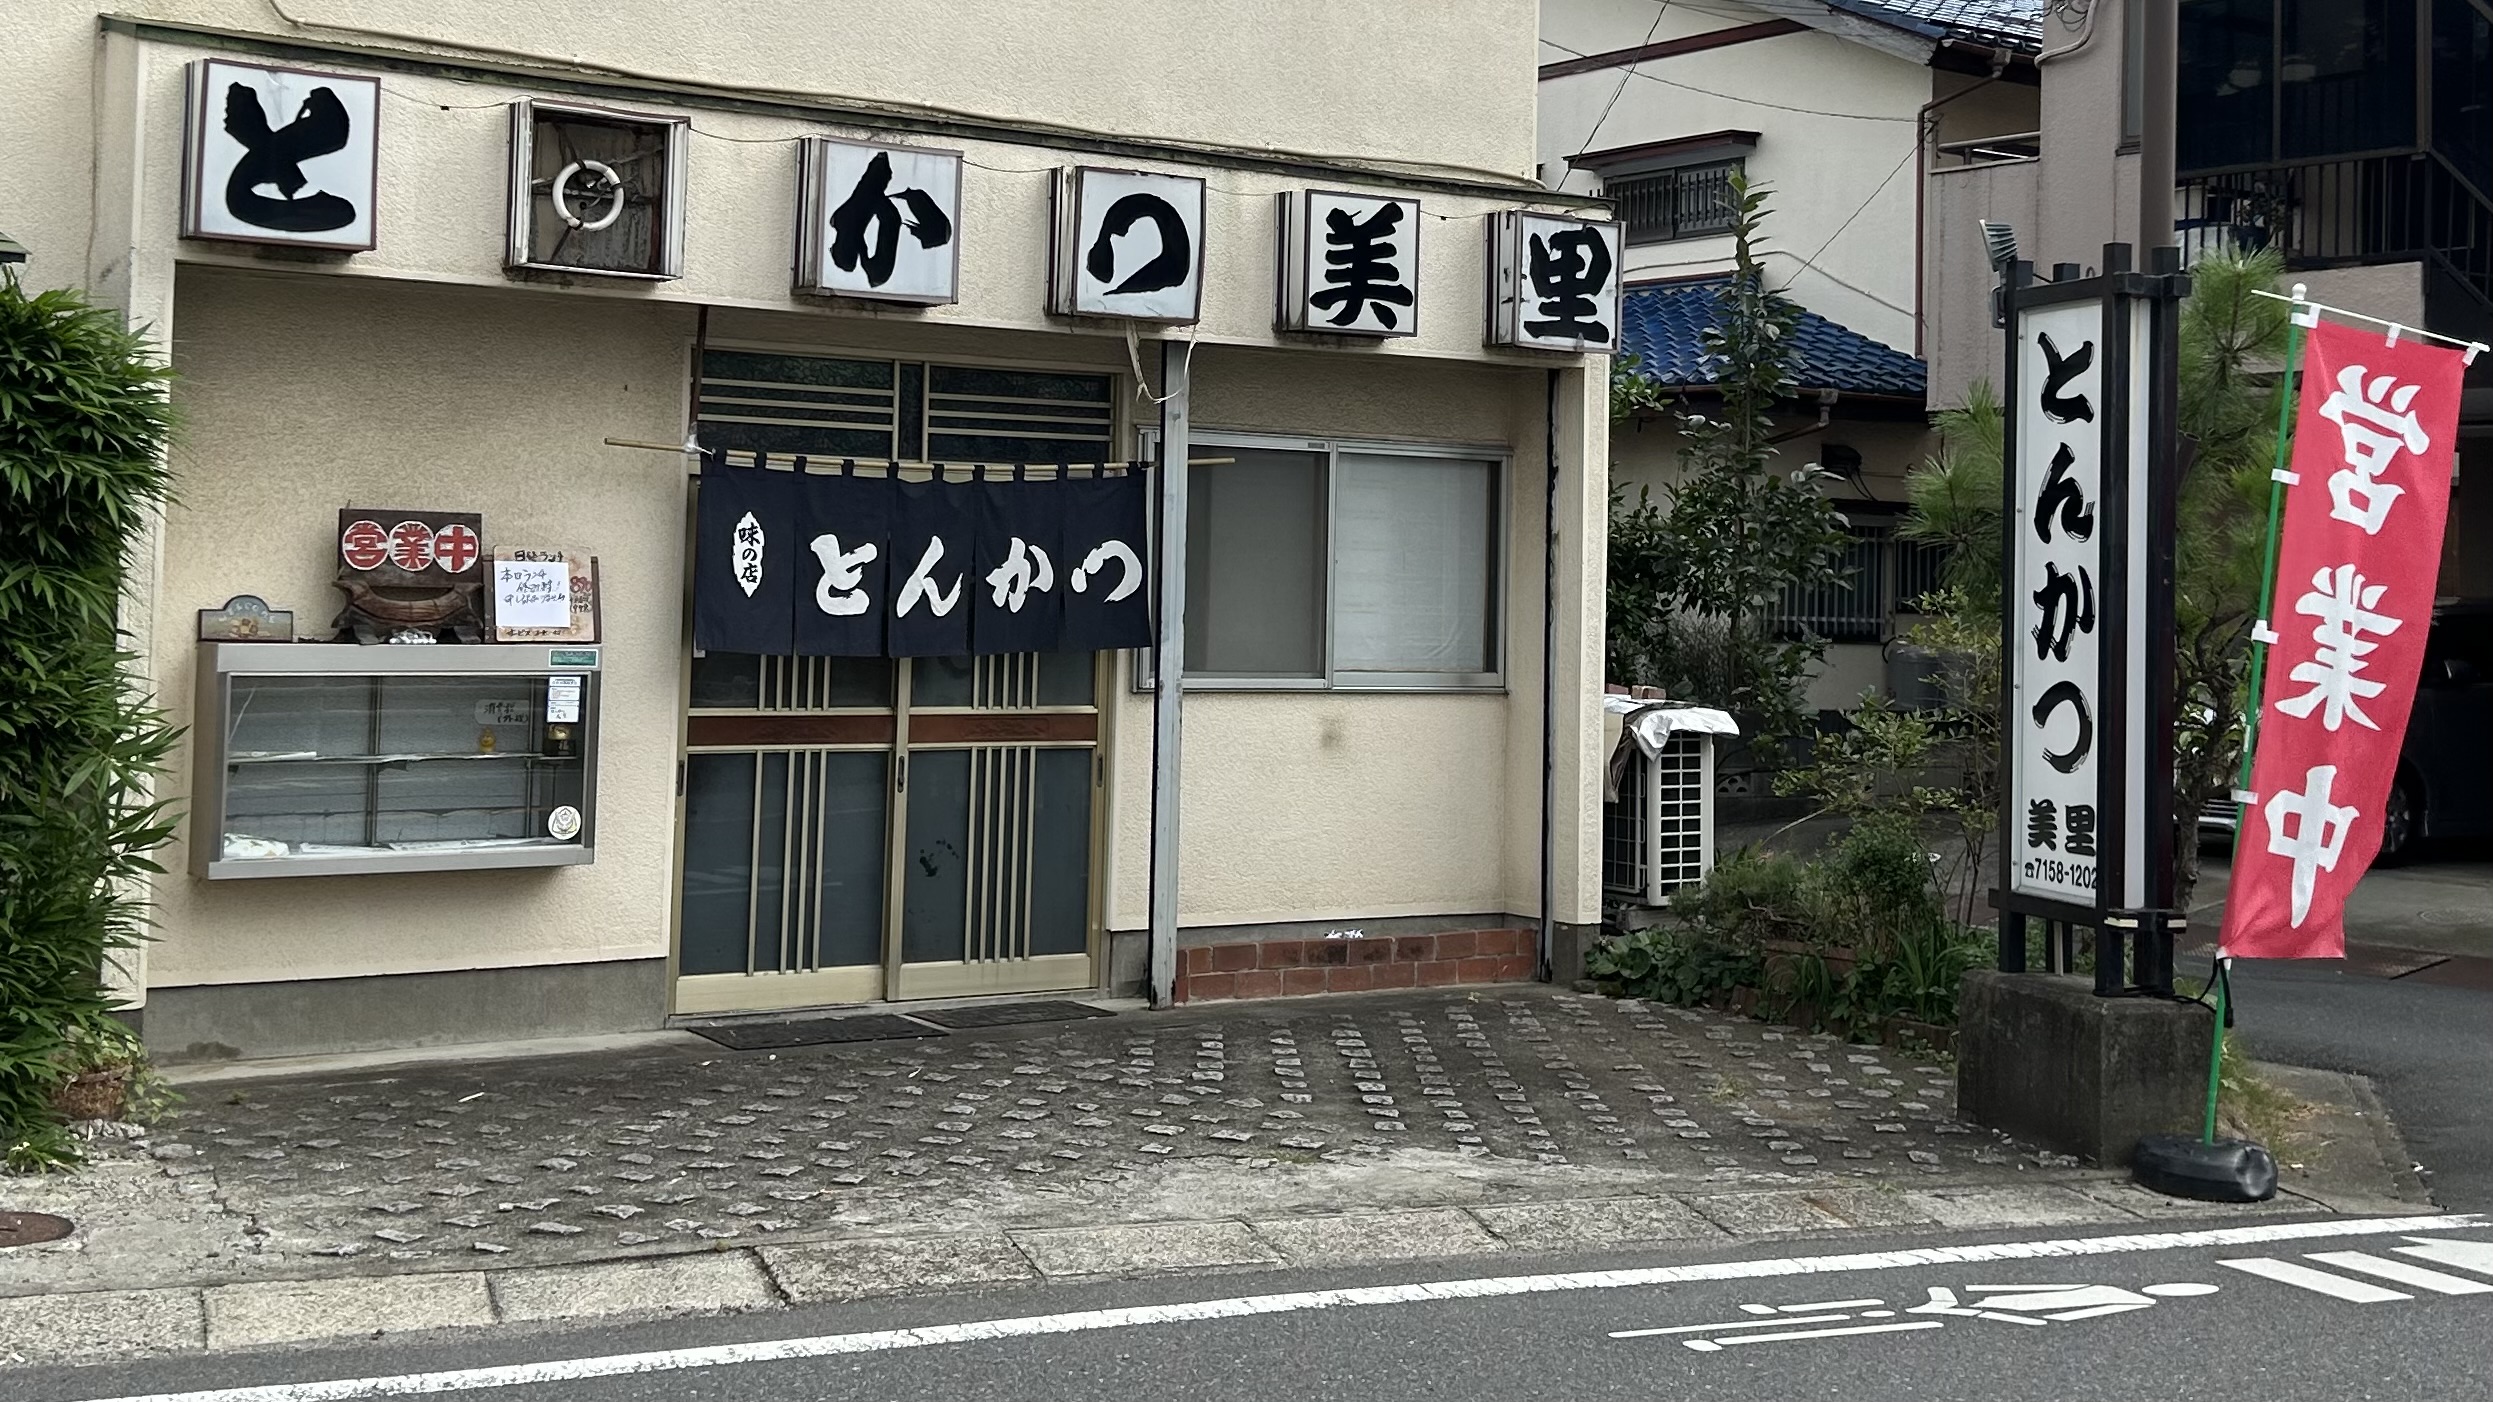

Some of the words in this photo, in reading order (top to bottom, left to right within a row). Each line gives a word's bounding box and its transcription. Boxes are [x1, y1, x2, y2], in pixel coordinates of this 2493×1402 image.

[224, 81, 356, 231] と
[830, 152, 951, 286] か
[1086, 192, 1191, 296] つ
[1310, 201, 1413, 329] 美
[1522, 223, 1612, 343] 里
[343, 520, 478, 573] 営業中
[738, 522, 760, 583] 味の店
[810, 533, 1143, 618] とんかつ
[2031, 332, 2096, 774] とんかつ
[2264, 364, 2430, 929] 営業中
[2028, 799, 2096, 857] 美里
